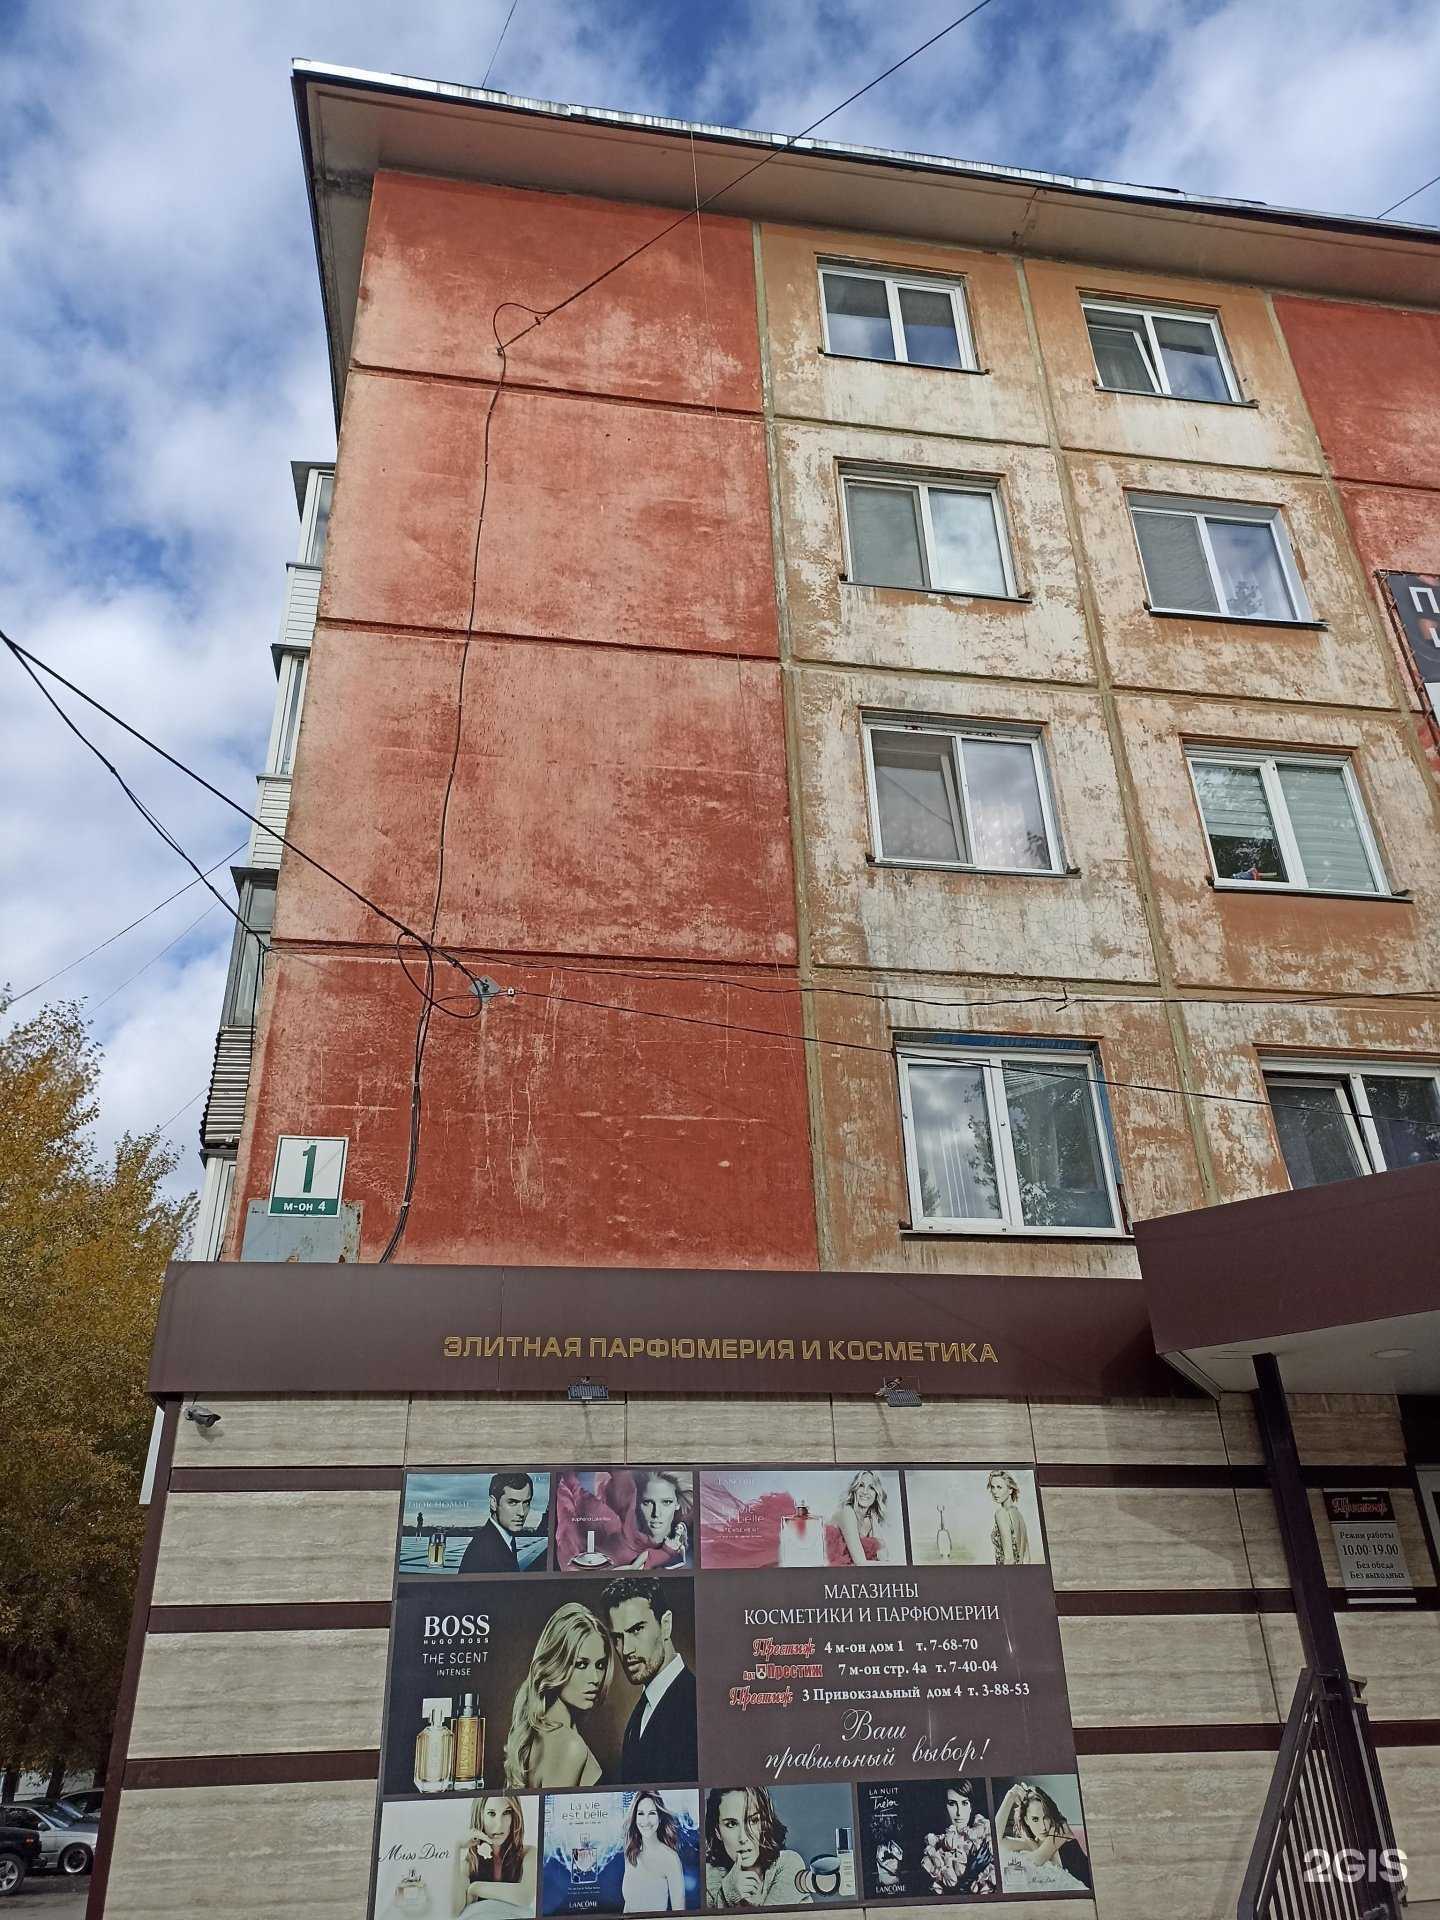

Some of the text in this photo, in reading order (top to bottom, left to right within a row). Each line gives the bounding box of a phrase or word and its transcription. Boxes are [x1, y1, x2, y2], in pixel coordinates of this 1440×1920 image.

[302, 1144, 318, 1194] 1
[317, 1200, 326, 1212] 4
[443, 1336, 999, 1364] ЭЛИТНАЯ ПАРФЮМЕРИЯ И КОСМЕТИКА
[1340, 1531, 1394, 1541] Режим работы
[1356, 1561, 1371, 1569] Без
[1350, 1571, 1365, 1579] Без
[823, 1583, 920, 1600] МАГАЗИНЫ
[743, 1605, 1000, 1625] КОСМЕТИКИ И ПАРФЮМЕРИИ
[423, 1614, 490, 1637] BOSS
[824, 1641, 833, 1654] 4
[835, 1643, 867, 1654] м-он
[869, 1642, 895, 1655] дом
[897, 1640, 904, 1652] 1
[915, 1641, 927, 1652] т.
[929, 1638, 978, 1651] 7-68-70
[422, 1651, 489, 1665] THE SCENT
[436, 1667, 472, 1677] INTENSE
[838, 1663, 846, 1676] 7
[849, 1665, 881, 1675] м-он
[883, 1665, 909, 1678] стр.
[911, 1661, 928, 1674] 4а
[935, 1663, 947, 1673] т.
[949, 1660, 999, 1673] 7-40-04
[802, 1689, 810, 1702] 3
[812, 1686, 921, 1704] Привокзальный
[926, 1687, 951, 1699] дом
[953, 1685, 962, 1697] 4
[967, 1686, 979, 1697] т.
[981, 1682, 1030, 1697] 3-88-53
[840, 1708, 907, 1742] Ваш
[765, 1735, 991, 1780] правильный выбор!
[868, 1787, 898, 1796] LA NUIT
[378, 1842, 450, 1863] Miss Dior
